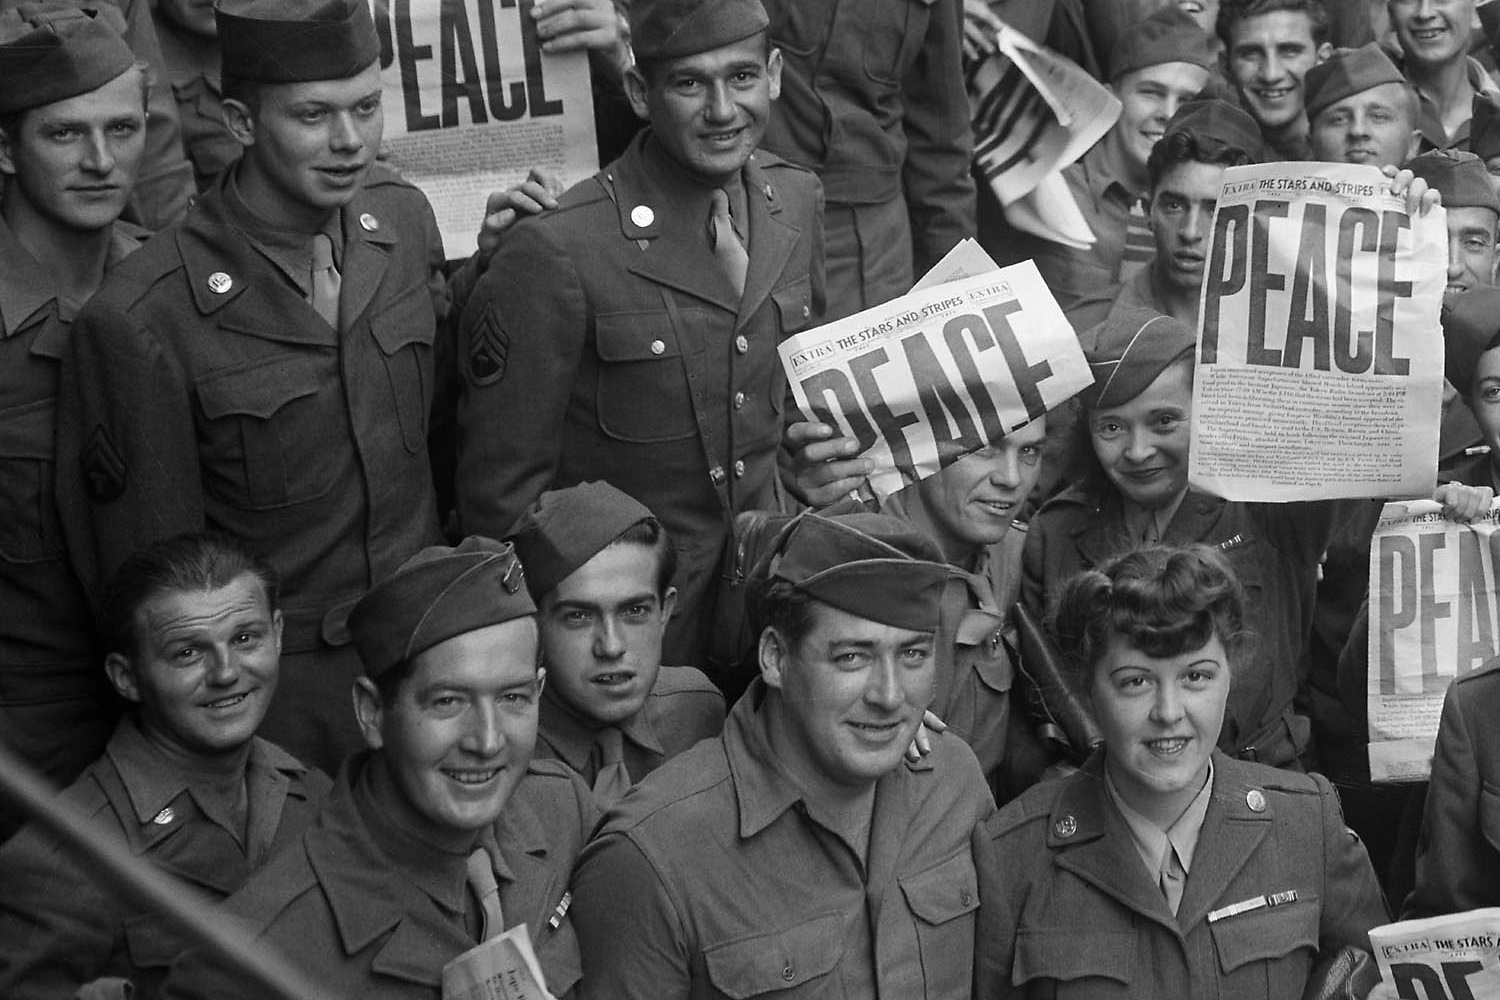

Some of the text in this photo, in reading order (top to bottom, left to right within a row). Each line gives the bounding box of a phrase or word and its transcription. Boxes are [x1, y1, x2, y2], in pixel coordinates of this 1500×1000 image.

[1259, 179, 1275, 190] THE
[1278, 180, 1306, 191] STARS
[1311, 181, 1332, 192] AND
[1335, 182, 1373, 196] STRIPES
[837, 335, 857, 351] THE
[858, 321, 893, 343] STARS
[896, 311, 919, 329] AND
[921, 296, 964, 318] STRIPES
[969, 284, 1009, 300] EXTRA
[1201, 200, 1413, 376] PEACE
[800, 299, 1054, 480] PEACE
[1434, 940, 1454, 950] THE
[1457, 936, 1493, 949] STARS
